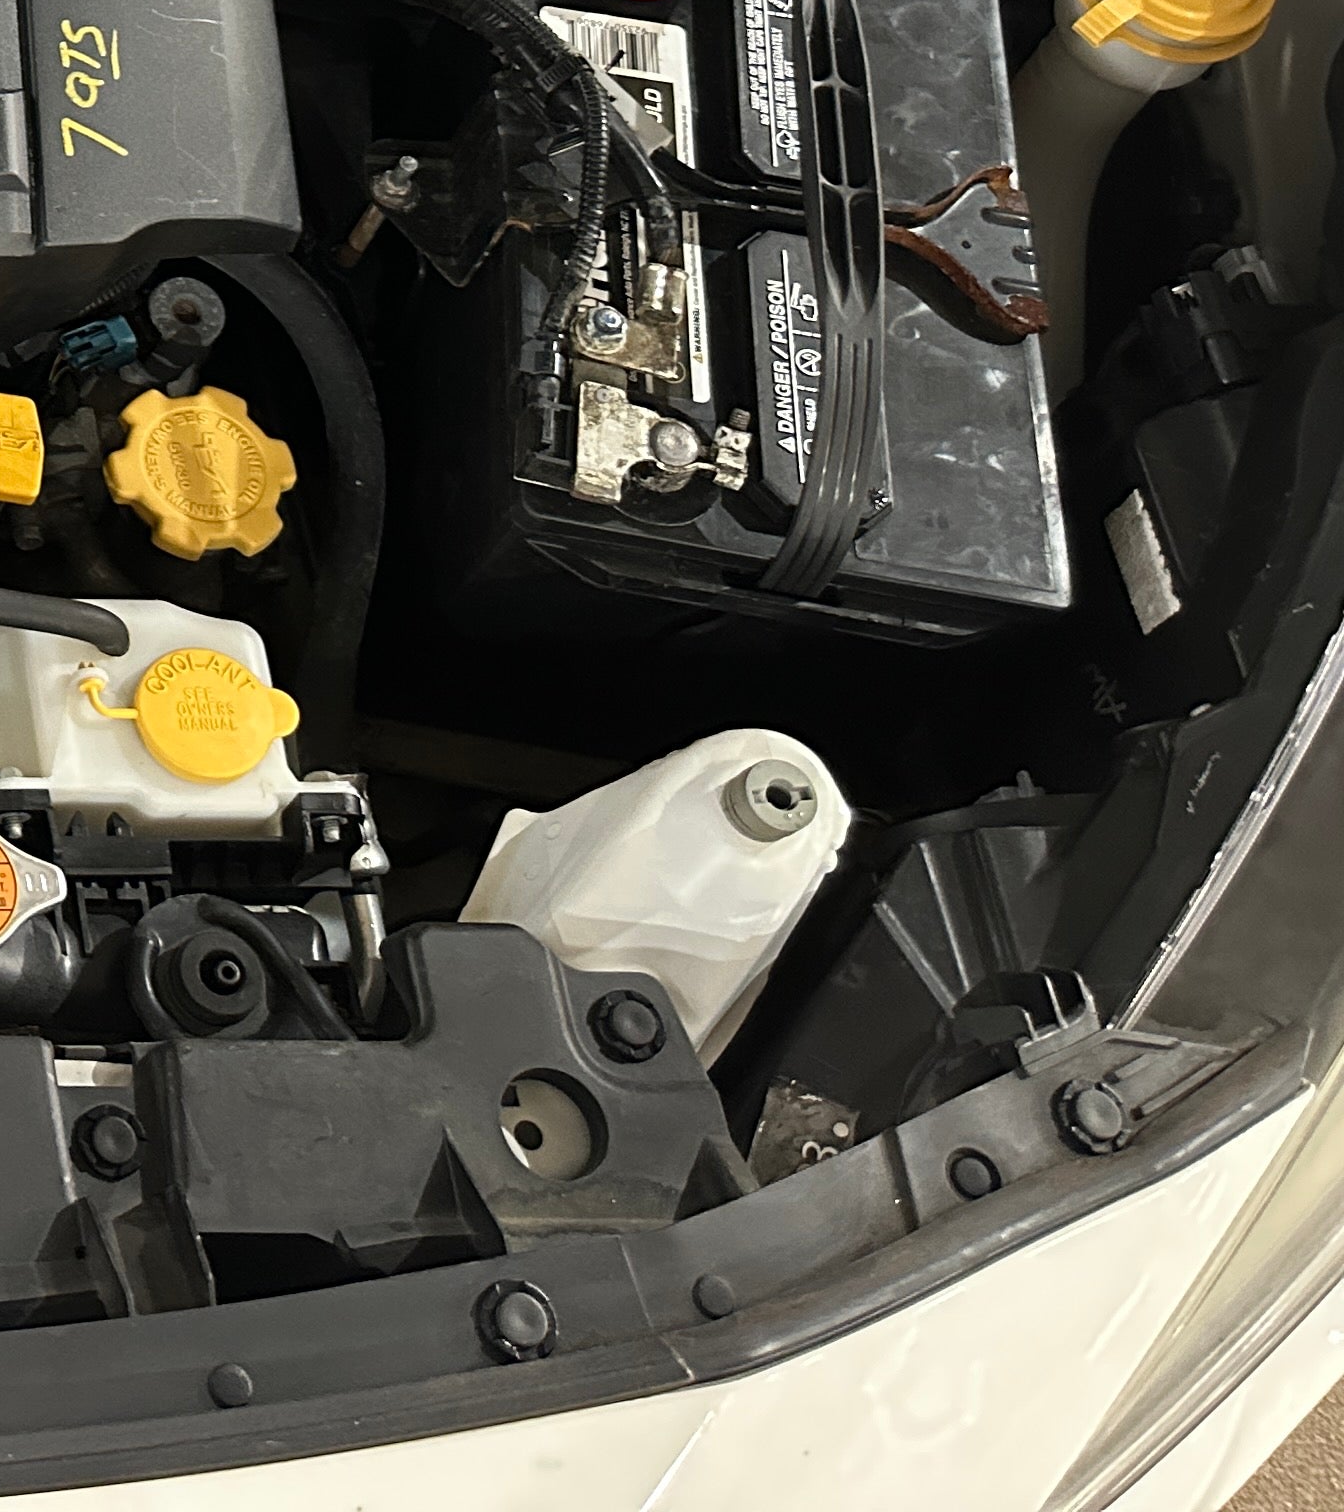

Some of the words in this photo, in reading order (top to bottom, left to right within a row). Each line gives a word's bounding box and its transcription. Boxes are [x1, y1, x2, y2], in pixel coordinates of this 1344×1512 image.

[766, 279, 788, 344] POISON
[772, 360, 795, 434] DANGER
[174, 410, 209, 426] SEE
[216, 416, 263, 477] ENGINE
[238, 478, 262, 503] OIL
[167, 490, 237, 519] MANUAL
[145, 652, 256, 694] COOLANT
[183, 686, 215, 702] SEE
[176, 701, 235, 717] OWNERS
[178, 717, 238, 732] MANUAL
